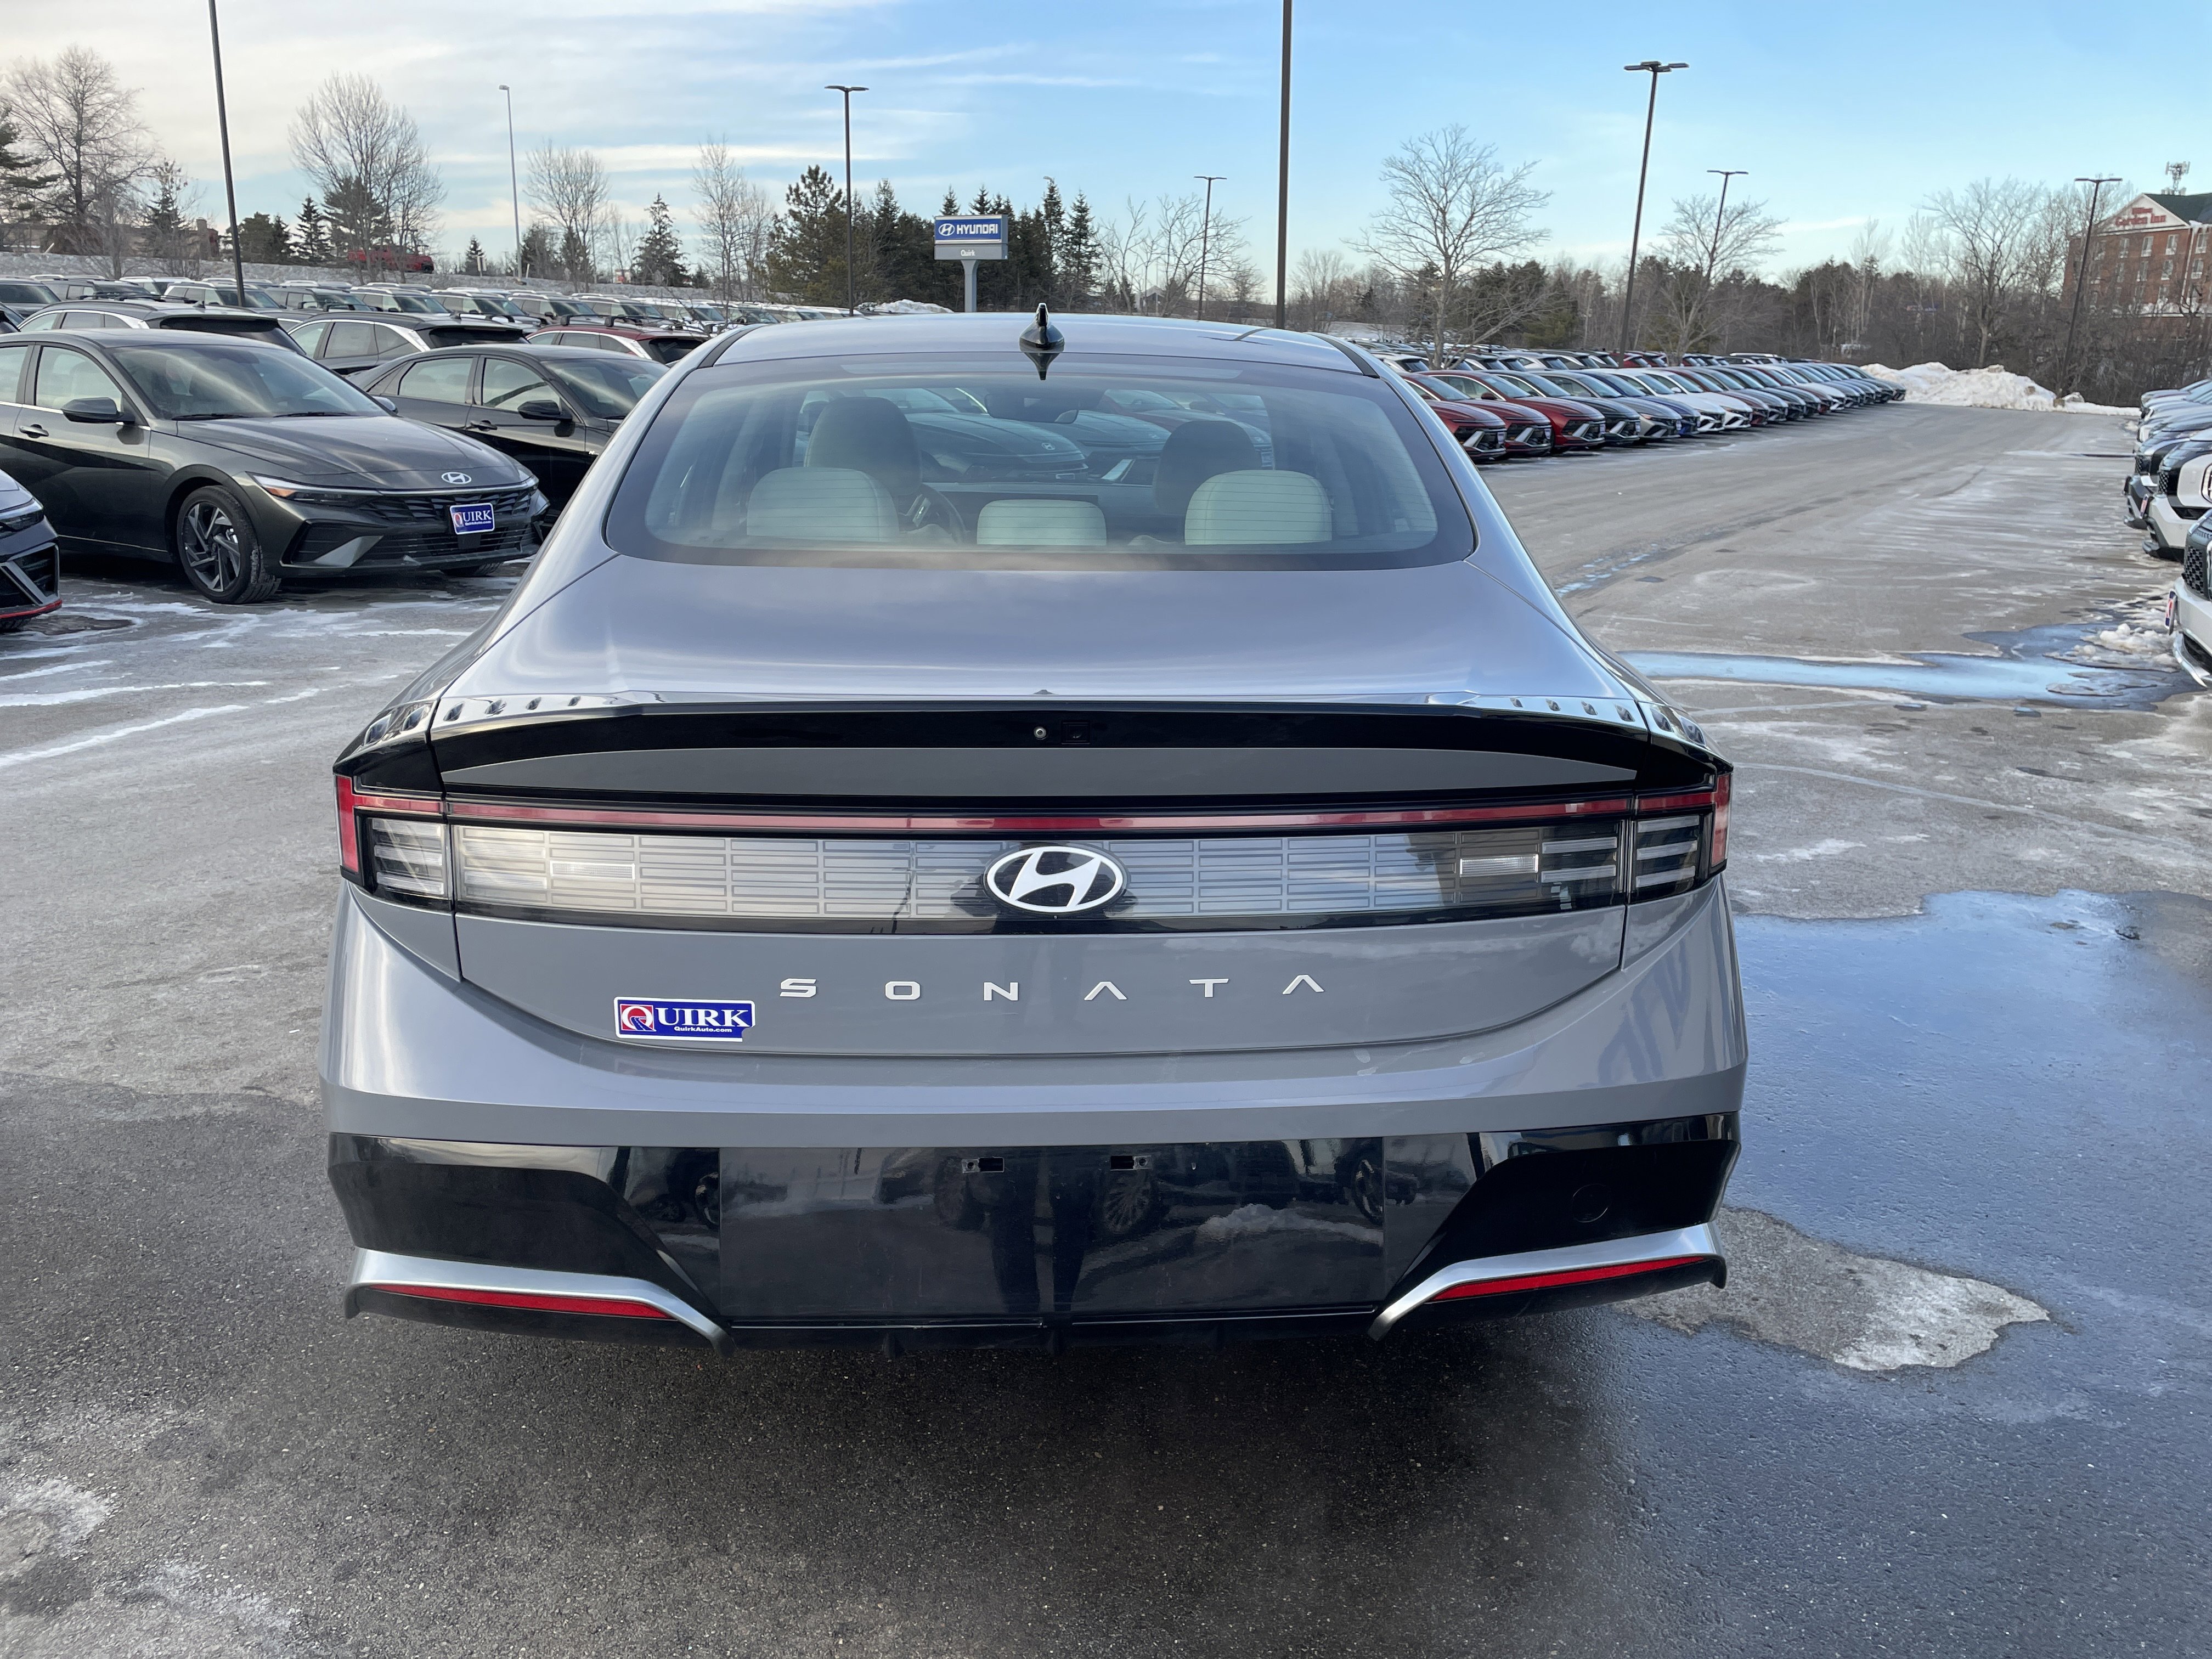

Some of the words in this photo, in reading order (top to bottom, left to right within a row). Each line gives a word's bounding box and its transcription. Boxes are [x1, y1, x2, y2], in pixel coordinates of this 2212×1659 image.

[956, 223, 998, 234] HYUNDAI
[453, 510, 493, 527] QUIRK
[779, 974, 1325, 1002] SONATA
[622, 1006, 751, 1032] QUIRK
